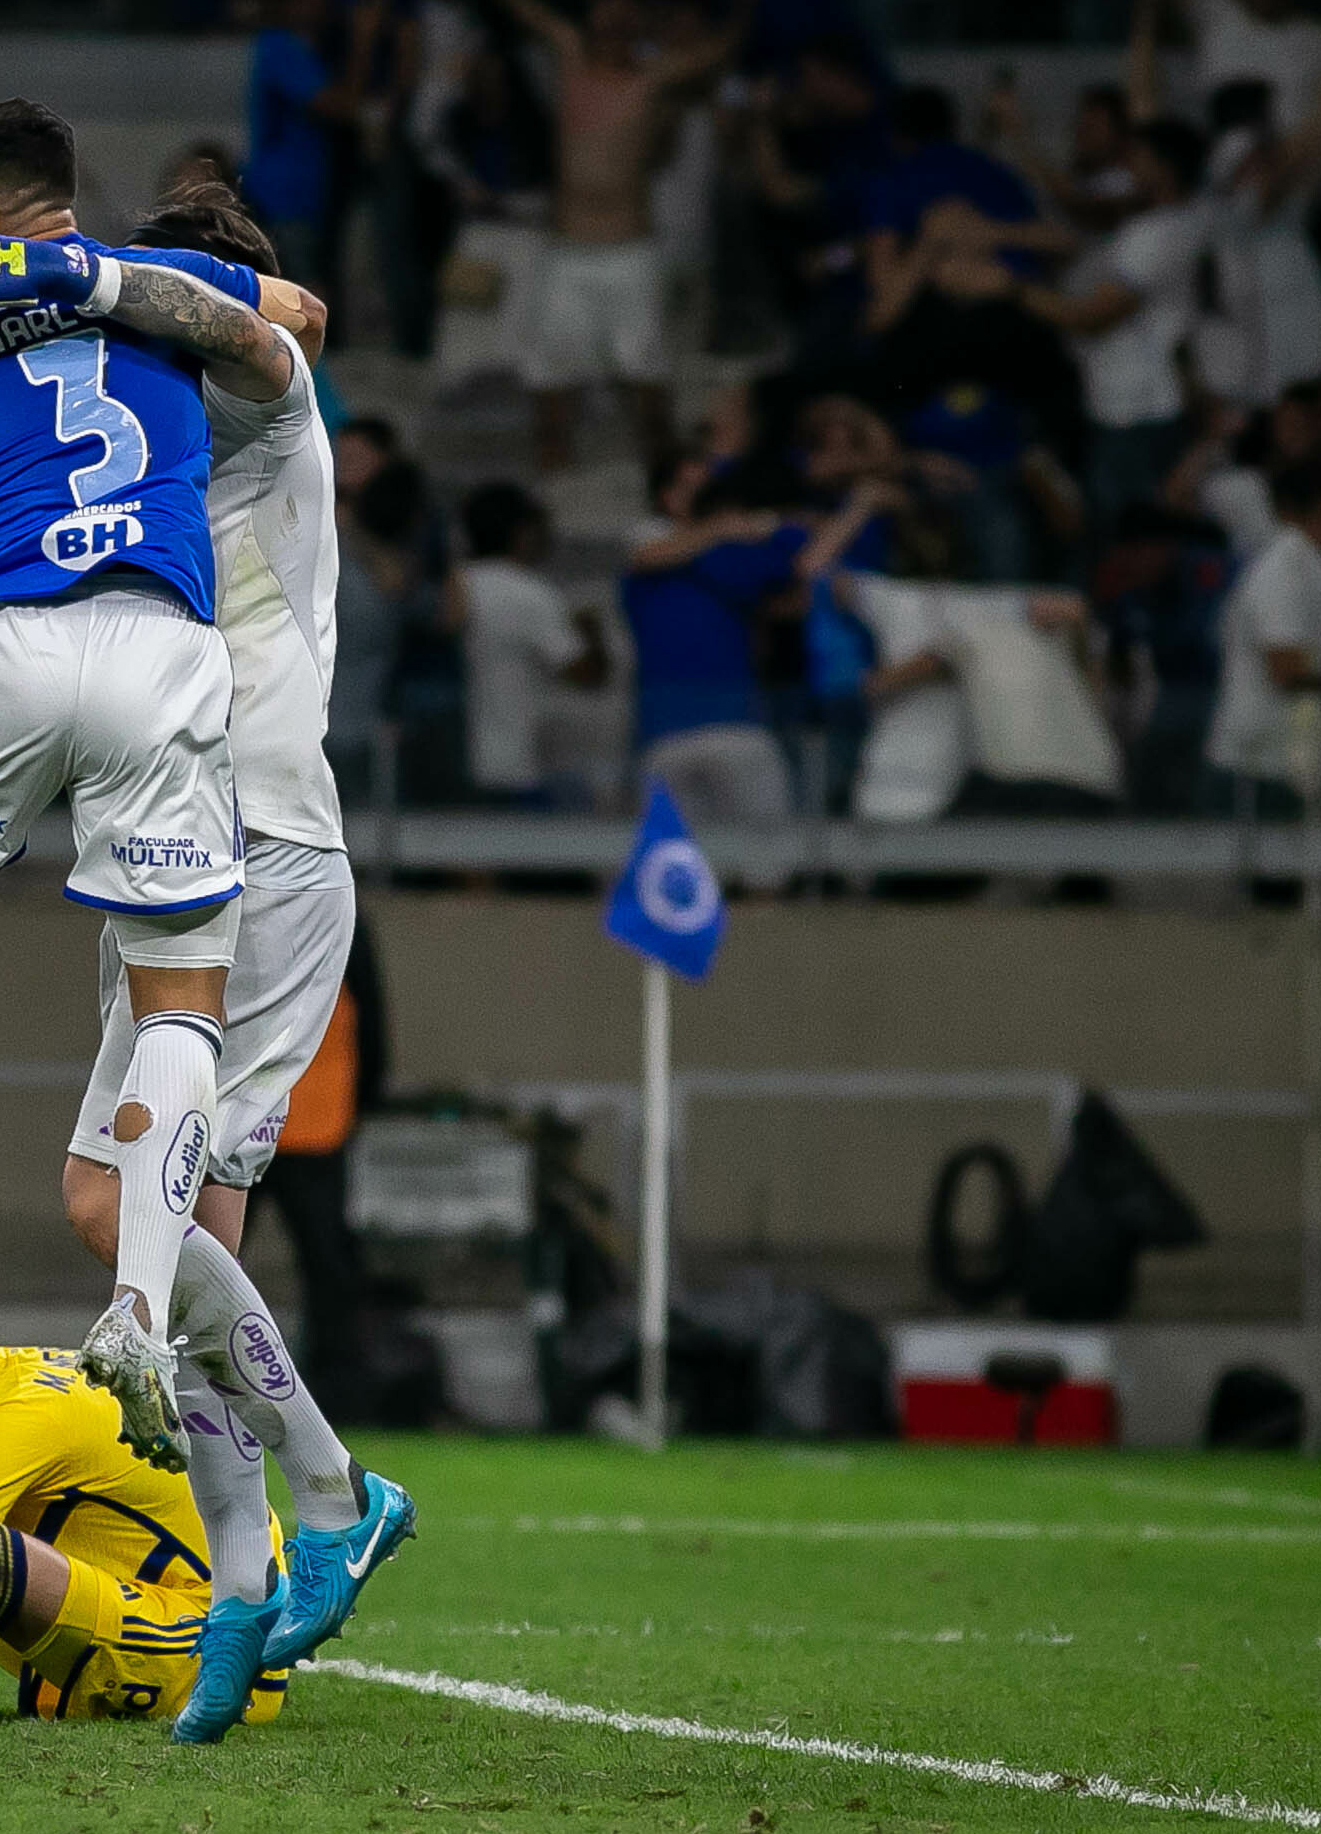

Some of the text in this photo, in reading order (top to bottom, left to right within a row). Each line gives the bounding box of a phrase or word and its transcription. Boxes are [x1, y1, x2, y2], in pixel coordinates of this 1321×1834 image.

[17, 327, 150, 509] 3
[56, 519, 128, 561] BH
[111, 842, 212, 868] MULTIVIX
[128, 837, 195, 848] FACULDADE
[241, 1323, 291, 1391] Kodilar
